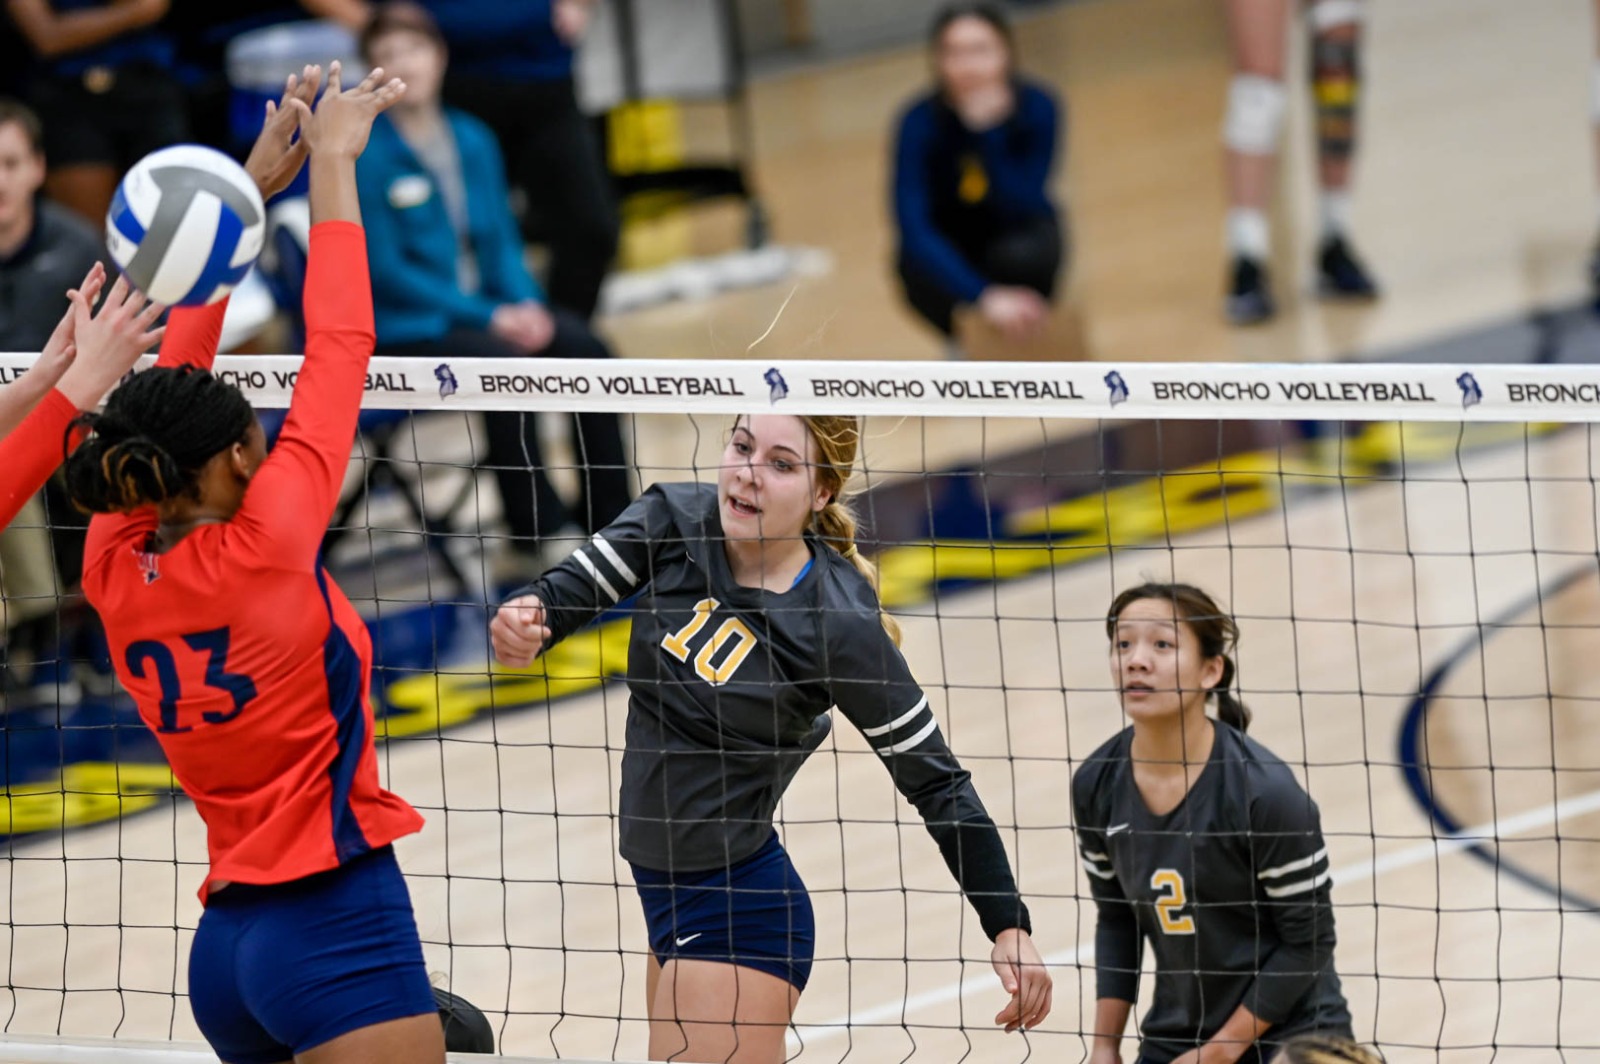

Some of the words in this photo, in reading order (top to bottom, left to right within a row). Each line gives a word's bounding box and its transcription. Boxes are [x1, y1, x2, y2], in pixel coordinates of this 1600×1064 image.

[479, 375, 590, 394] BRONCHO
[597, 376, 744, 396] VOLLEYBALL
[811, 379, 925, 398] BRONCHO
[932, 380, 1083, 399] VOLLEYBALL
[1153, 381, 1270, 400] BRONCHO
[1278, 382, 1436, 402] VOLLEYBALL
[661, 597, 757, 687] 10
[125, 625, 258, 733] 23
[1150, 868, 1196, 935] 2
